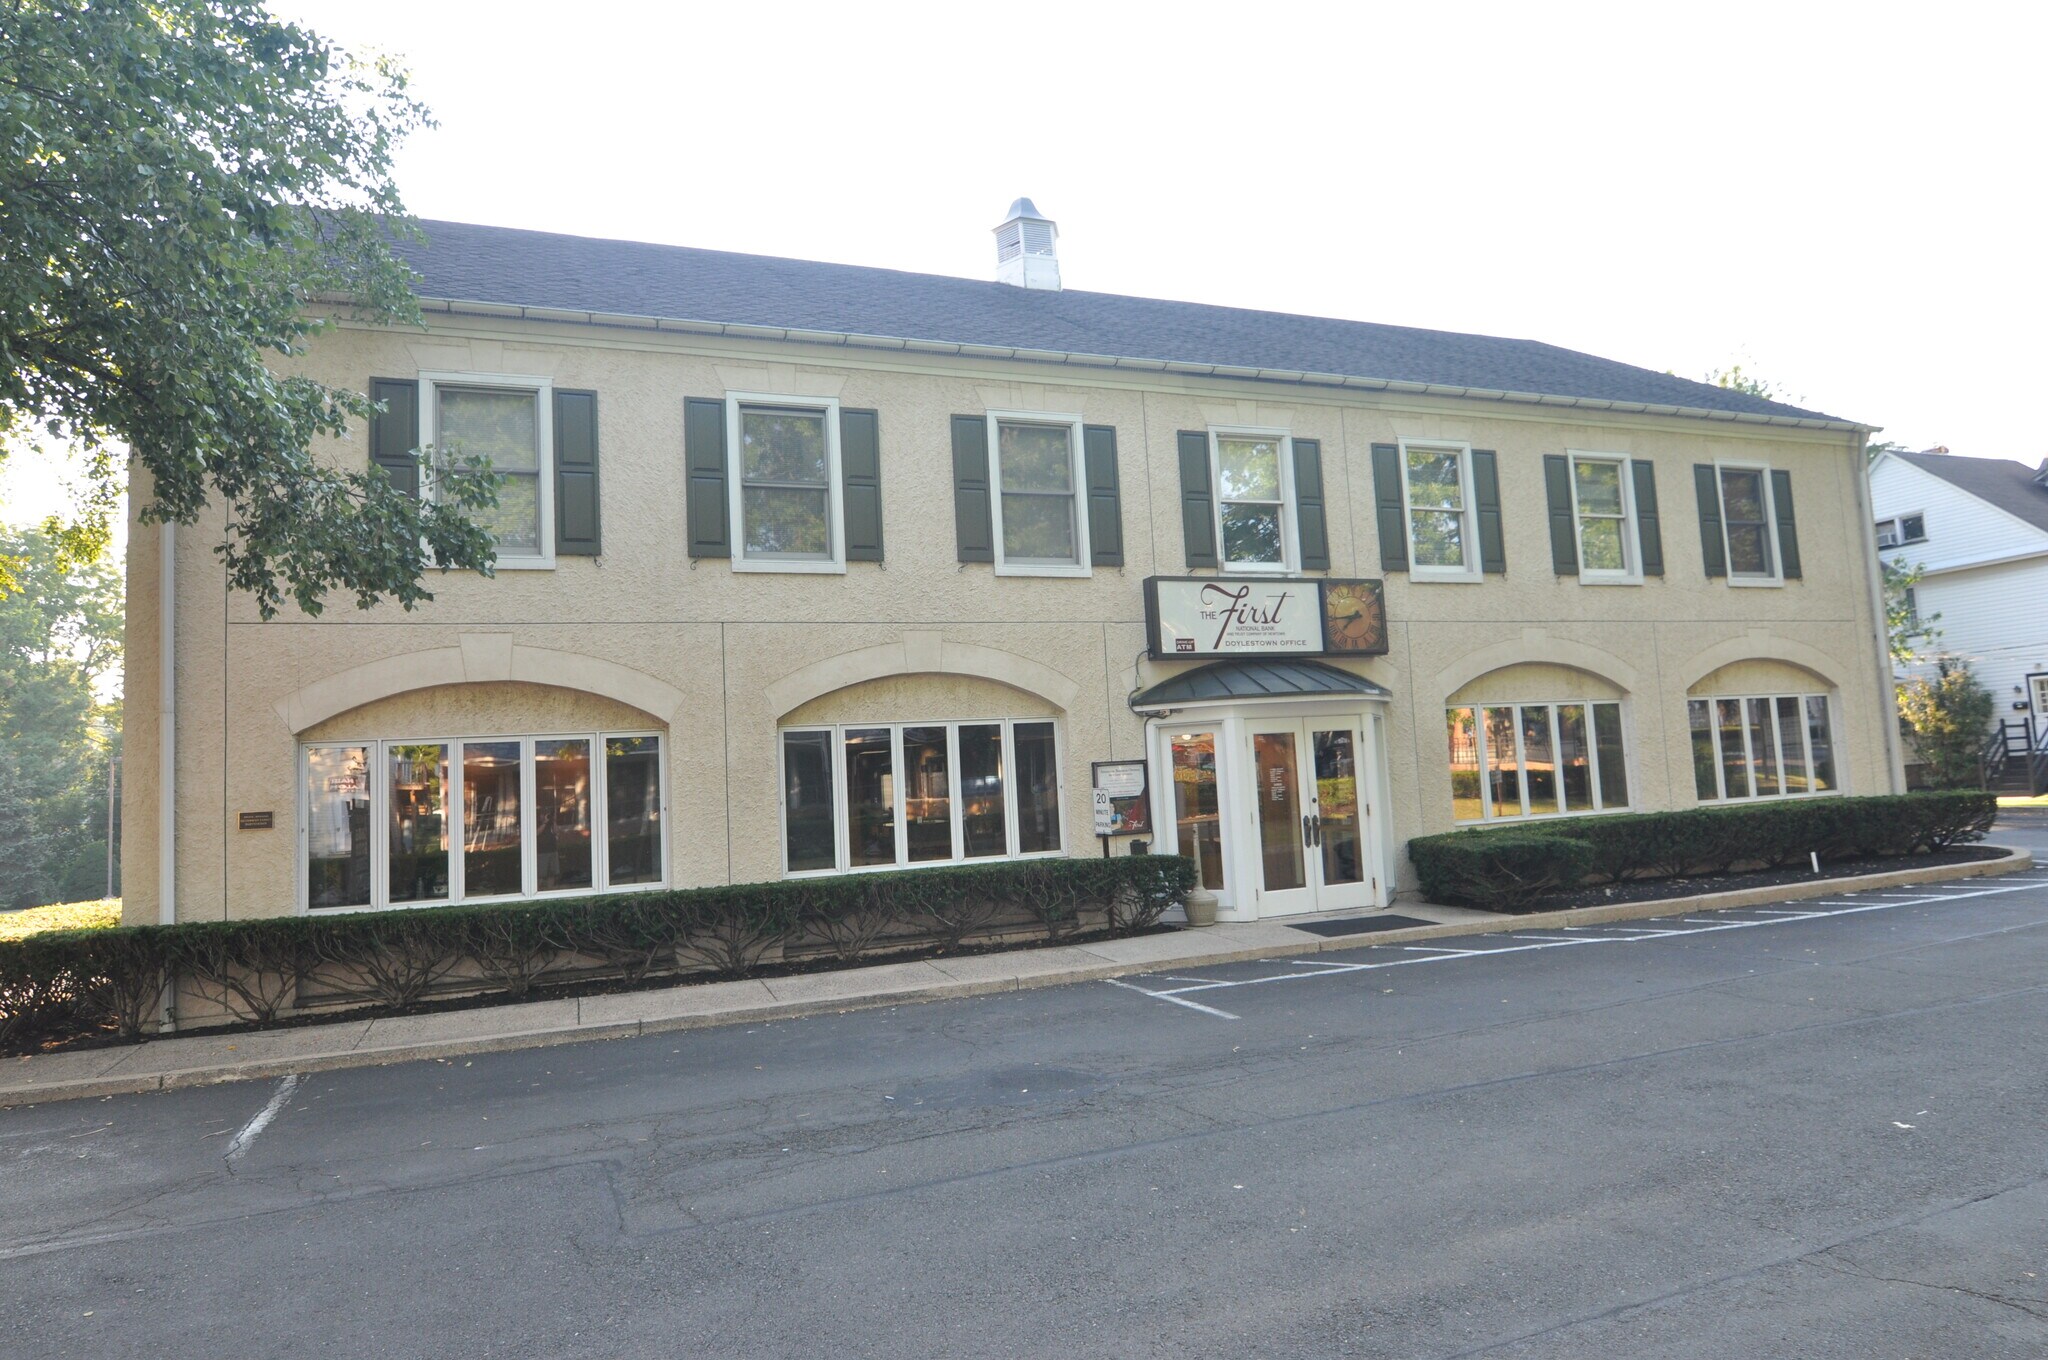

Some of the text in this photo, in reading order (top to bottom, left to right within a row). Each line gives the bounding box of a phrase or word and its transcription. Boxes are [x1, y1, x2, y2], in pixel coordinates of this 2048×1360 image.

[1200, 584, 1295, 650] THE First
[1225, 639, 1278, 647] DOYLESTOWN
[1096, 793, 1106, 804] 20
